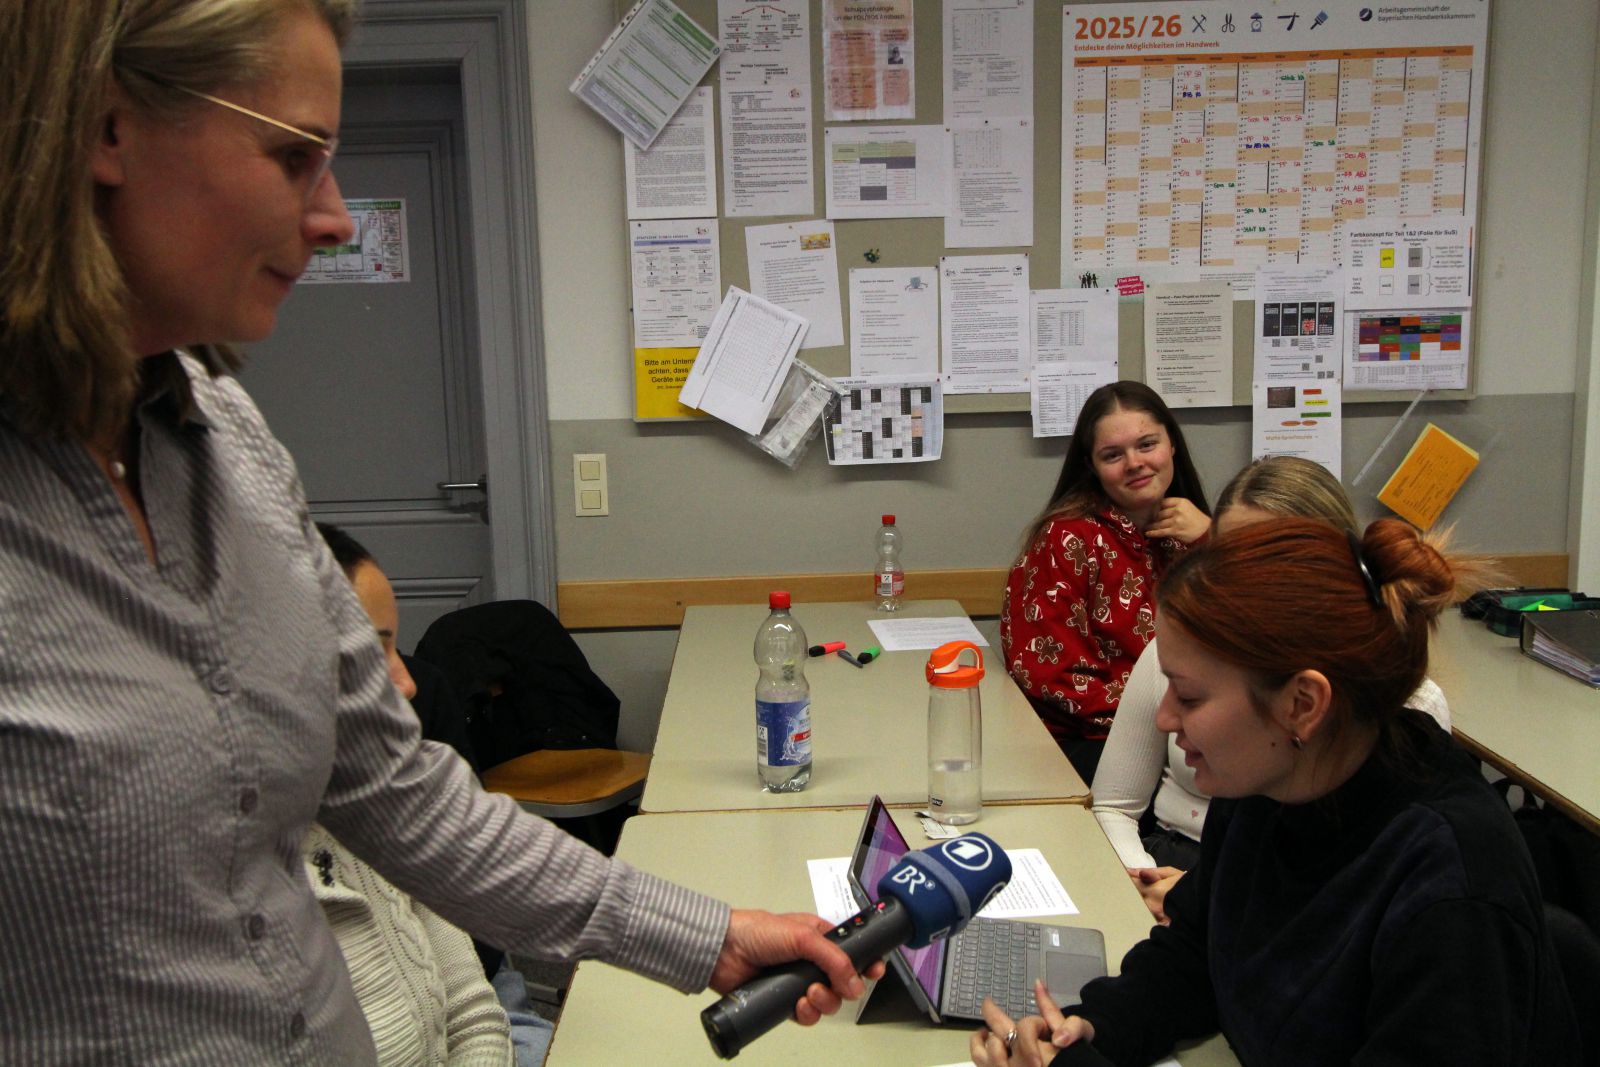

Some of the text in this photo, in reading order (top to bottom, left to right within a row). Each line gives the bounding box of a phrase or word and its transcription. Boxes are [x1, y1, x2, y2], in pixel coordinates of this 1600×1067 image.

[1074, 14, 1183, 40] 2025/26
[1074, 43, 1105, 51] Entdecke
[1125, 42, 1175, 51] Möglichkeiten
[891, 864, 926, 896] BR
